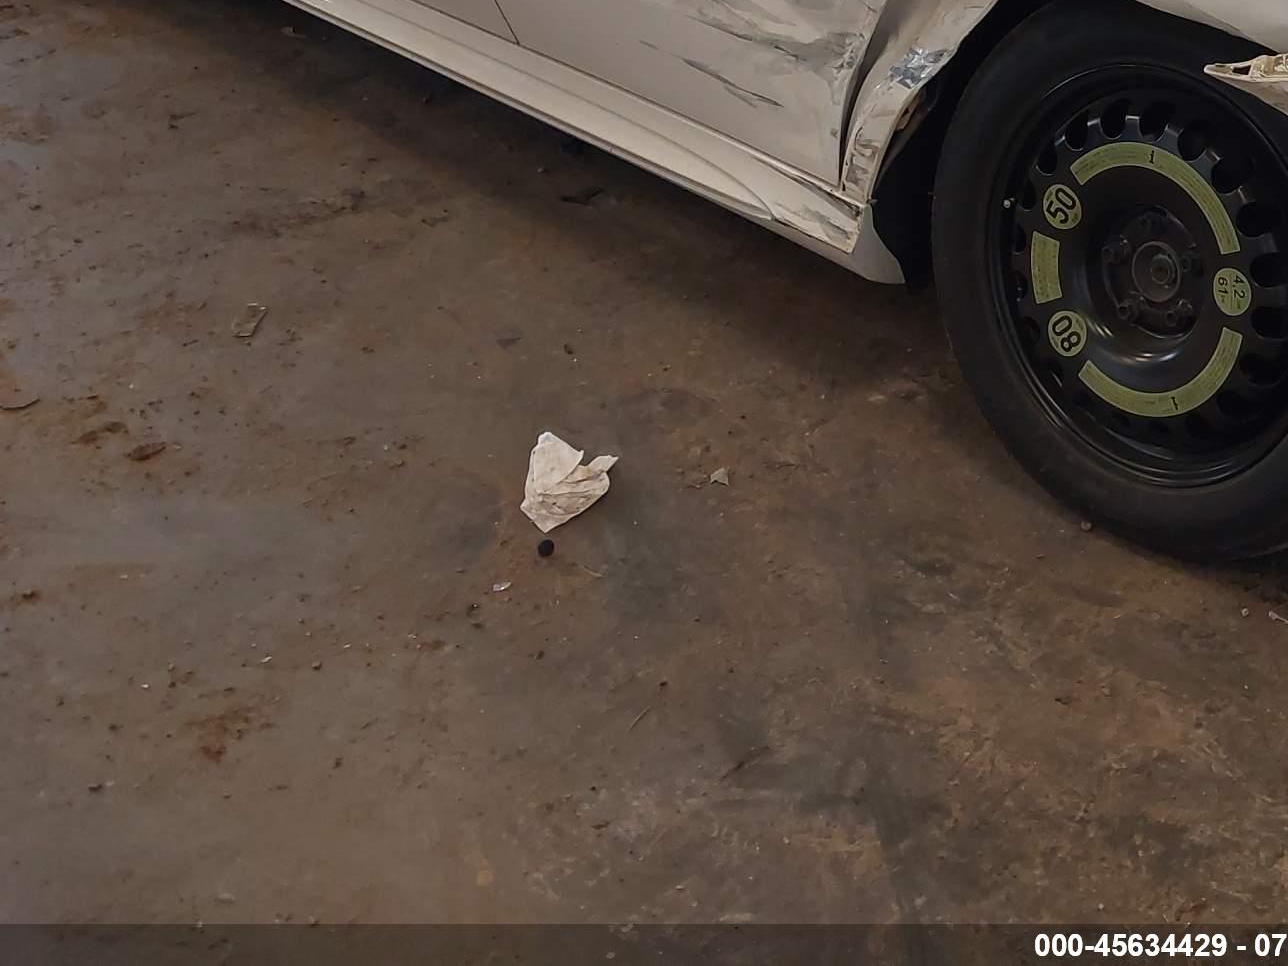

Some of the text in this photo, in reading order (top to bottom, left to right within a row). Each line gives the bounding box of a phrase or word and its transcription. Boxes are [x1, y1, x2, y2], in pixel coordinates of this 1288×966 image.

[1045, 187, 1077, 225] 50
[1217, 276, 1229, 294] 61
[1051, 314, 1082, 353] 80
